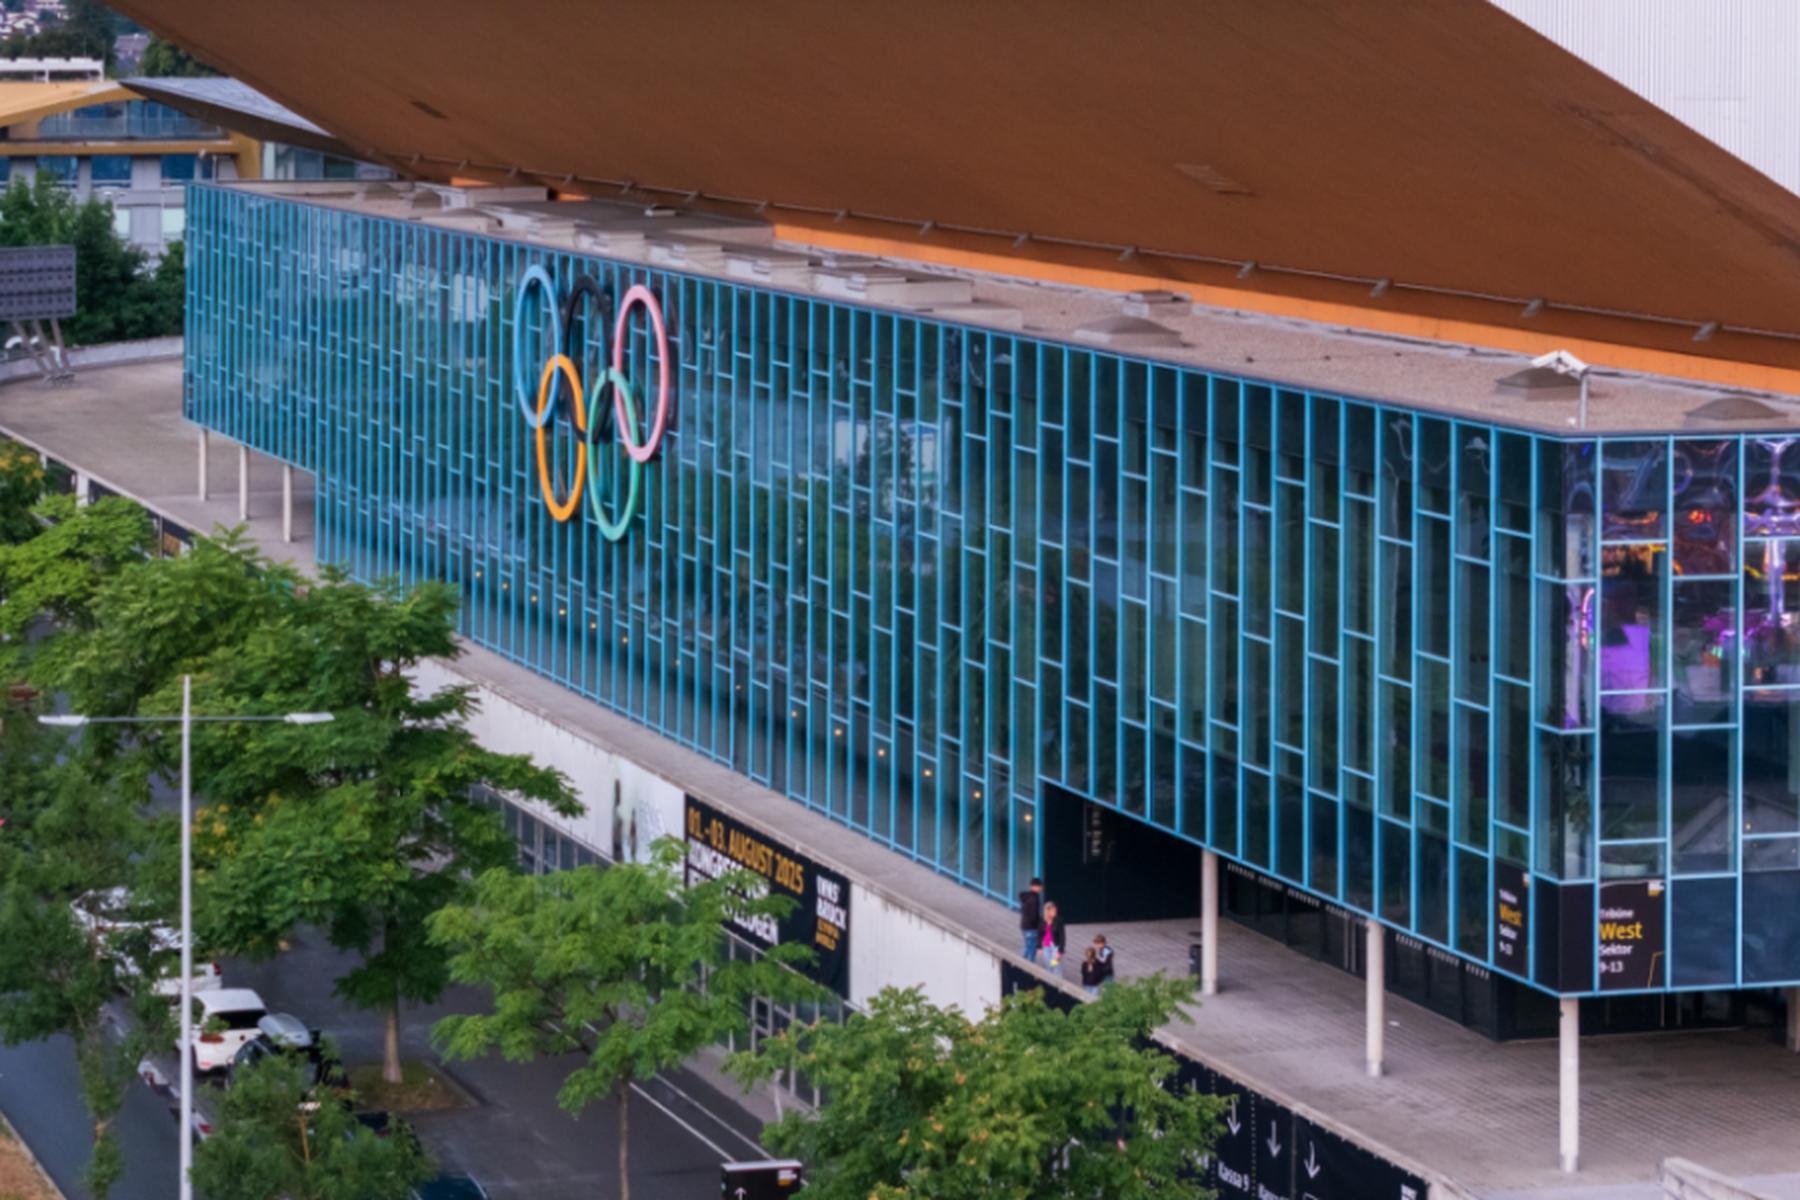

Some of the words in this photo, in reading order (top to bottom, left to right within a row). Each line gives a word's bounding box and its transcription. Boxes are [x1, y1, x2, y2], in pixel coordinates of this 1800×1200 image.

[728, 829, 773, 878] AUGUST
[774, 853, 805, 896] 2025
[1599, 921, 1642, 940] West
